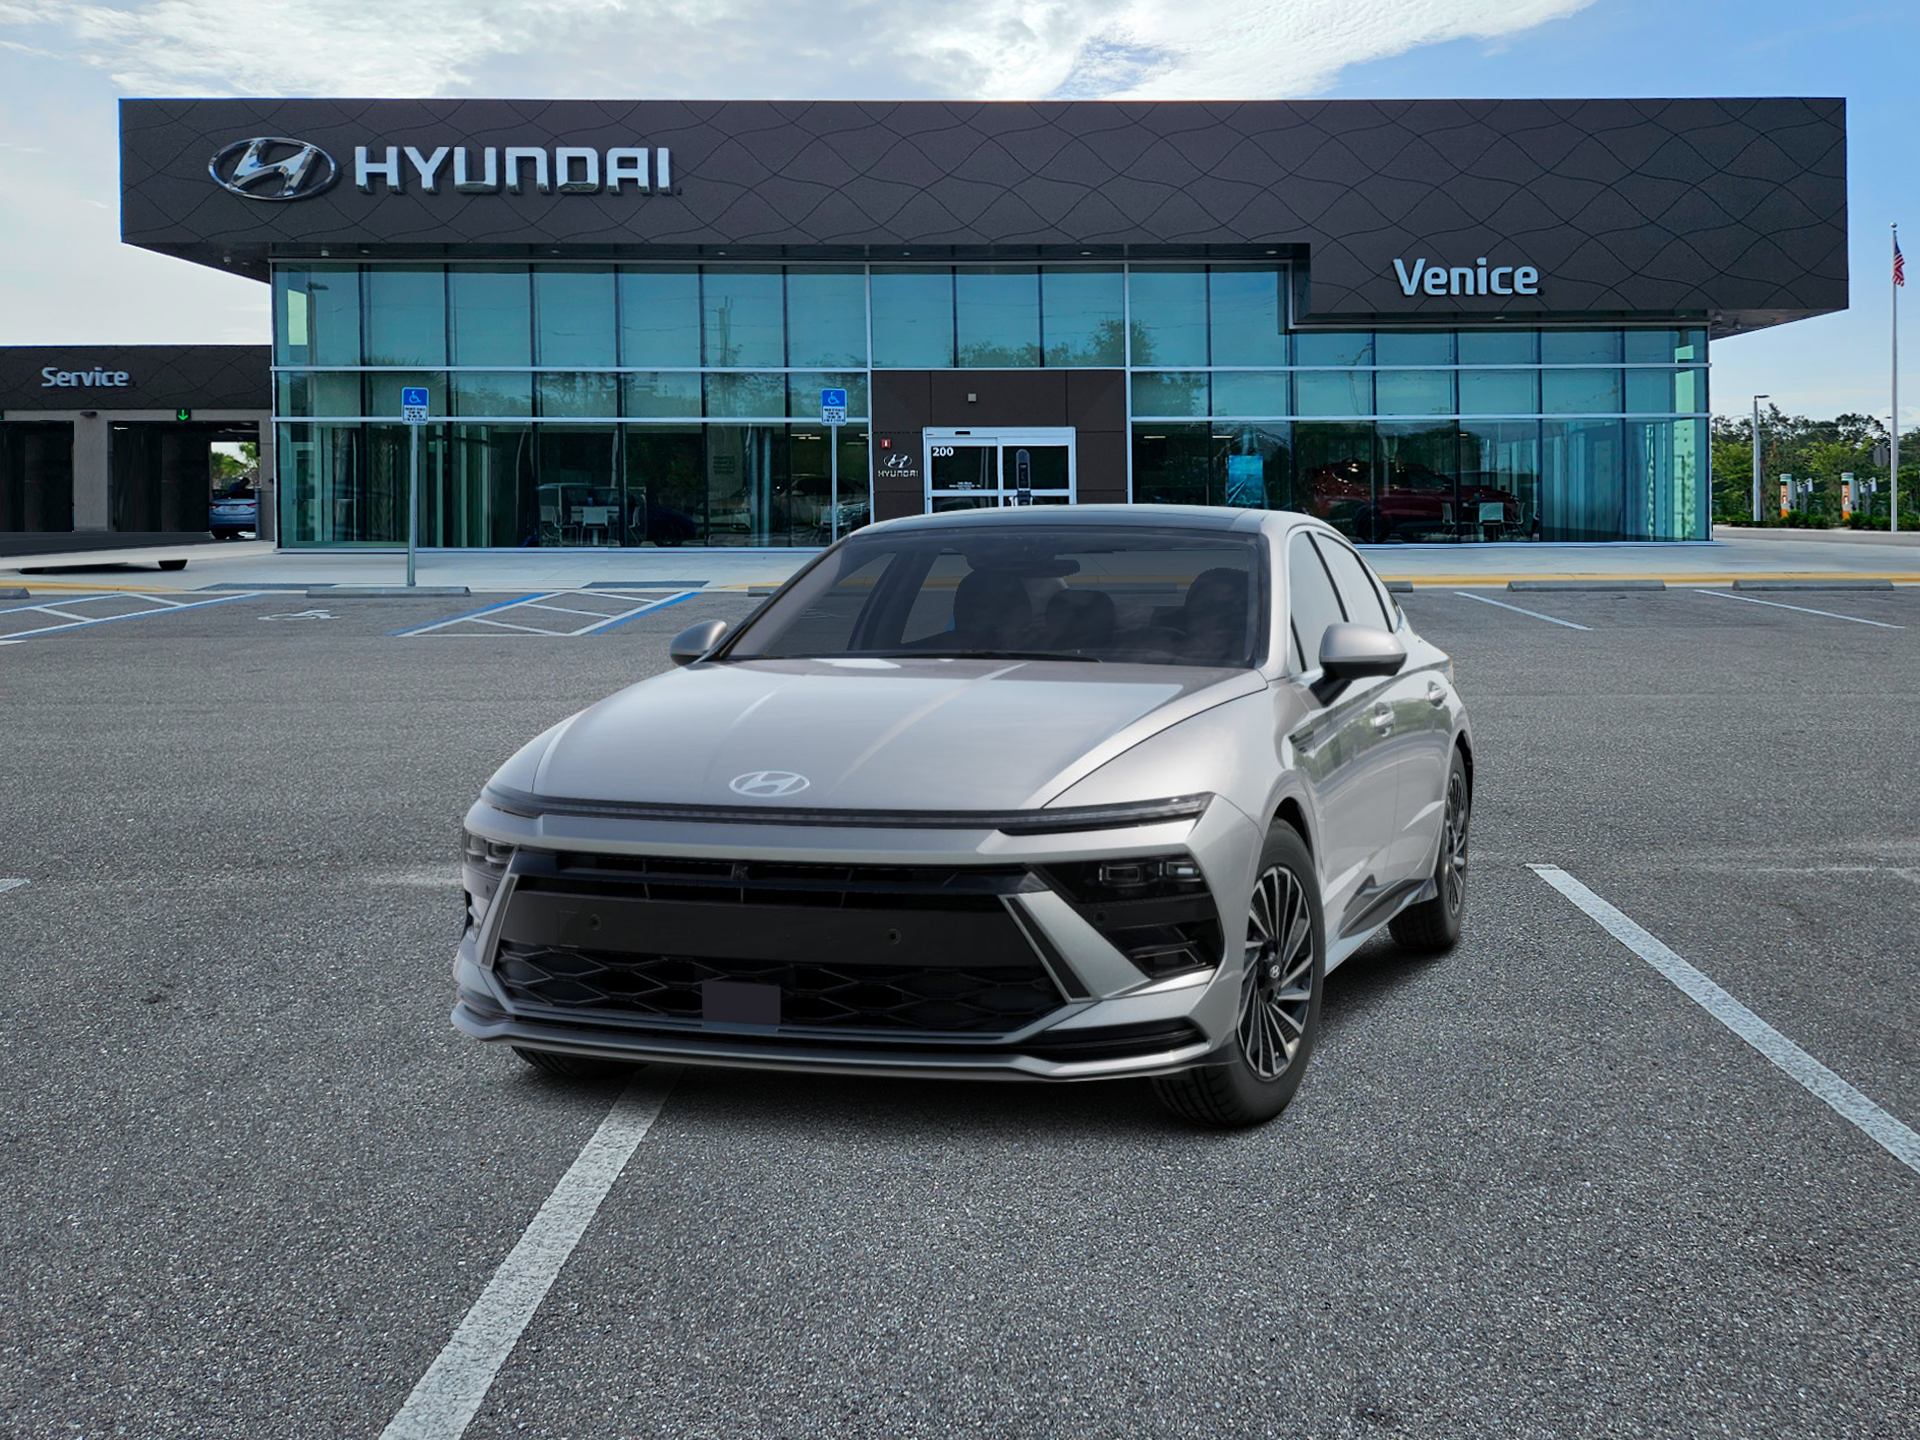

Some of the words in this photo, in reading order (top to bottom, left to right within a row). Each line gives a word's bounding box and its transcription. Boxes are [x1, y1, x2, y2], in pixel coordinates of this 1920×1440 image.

[355, 146, 671, 194] HYUNDAI
[1393, 257, 1539, 296] Venice
[41, 366, 130, 387] Service
[932, 447, 954, 457] 200
[877, 470, 919, 478] HYUNDAI
